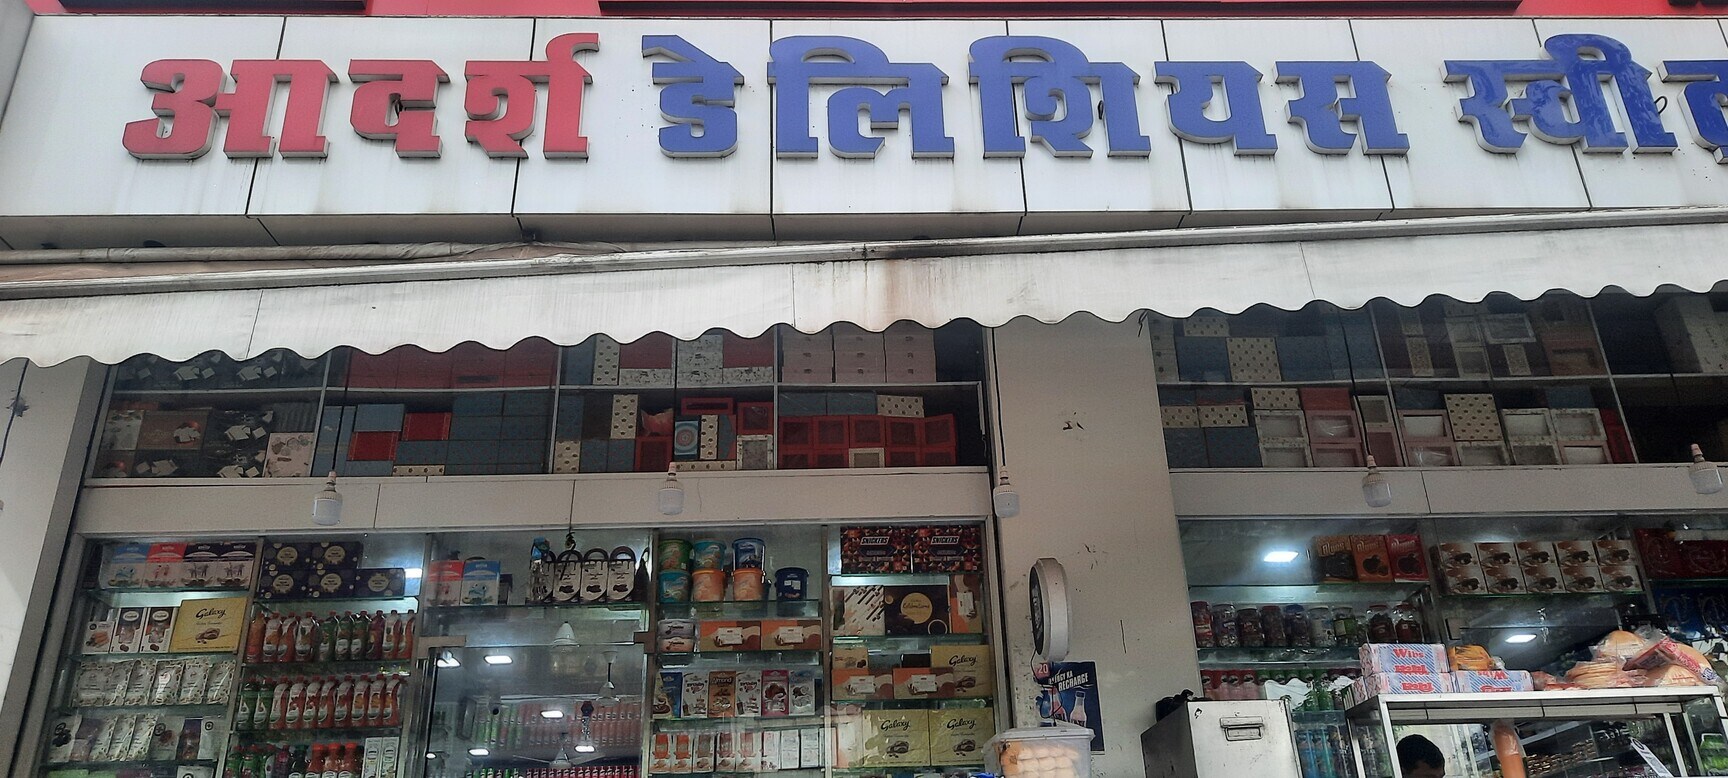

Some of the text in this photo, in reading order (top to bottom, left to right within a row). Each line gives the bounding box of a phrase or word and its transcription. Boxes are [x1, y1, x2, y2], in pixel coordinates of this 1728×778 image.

[123, 33, 598, 159] आदर्श
[642, 34, 1409, 159] डेलिशियस
[195, 607, 227, 620] Galaxy
[1393, 648, 1424, 658] Wibs
[948, 654, 978, 666] Galaxy
[1058, 672, 1089, 692] RECHARGE
[881, 719, 911, 731] Galaxy
[946, 717, 977, 730] Galaxy
